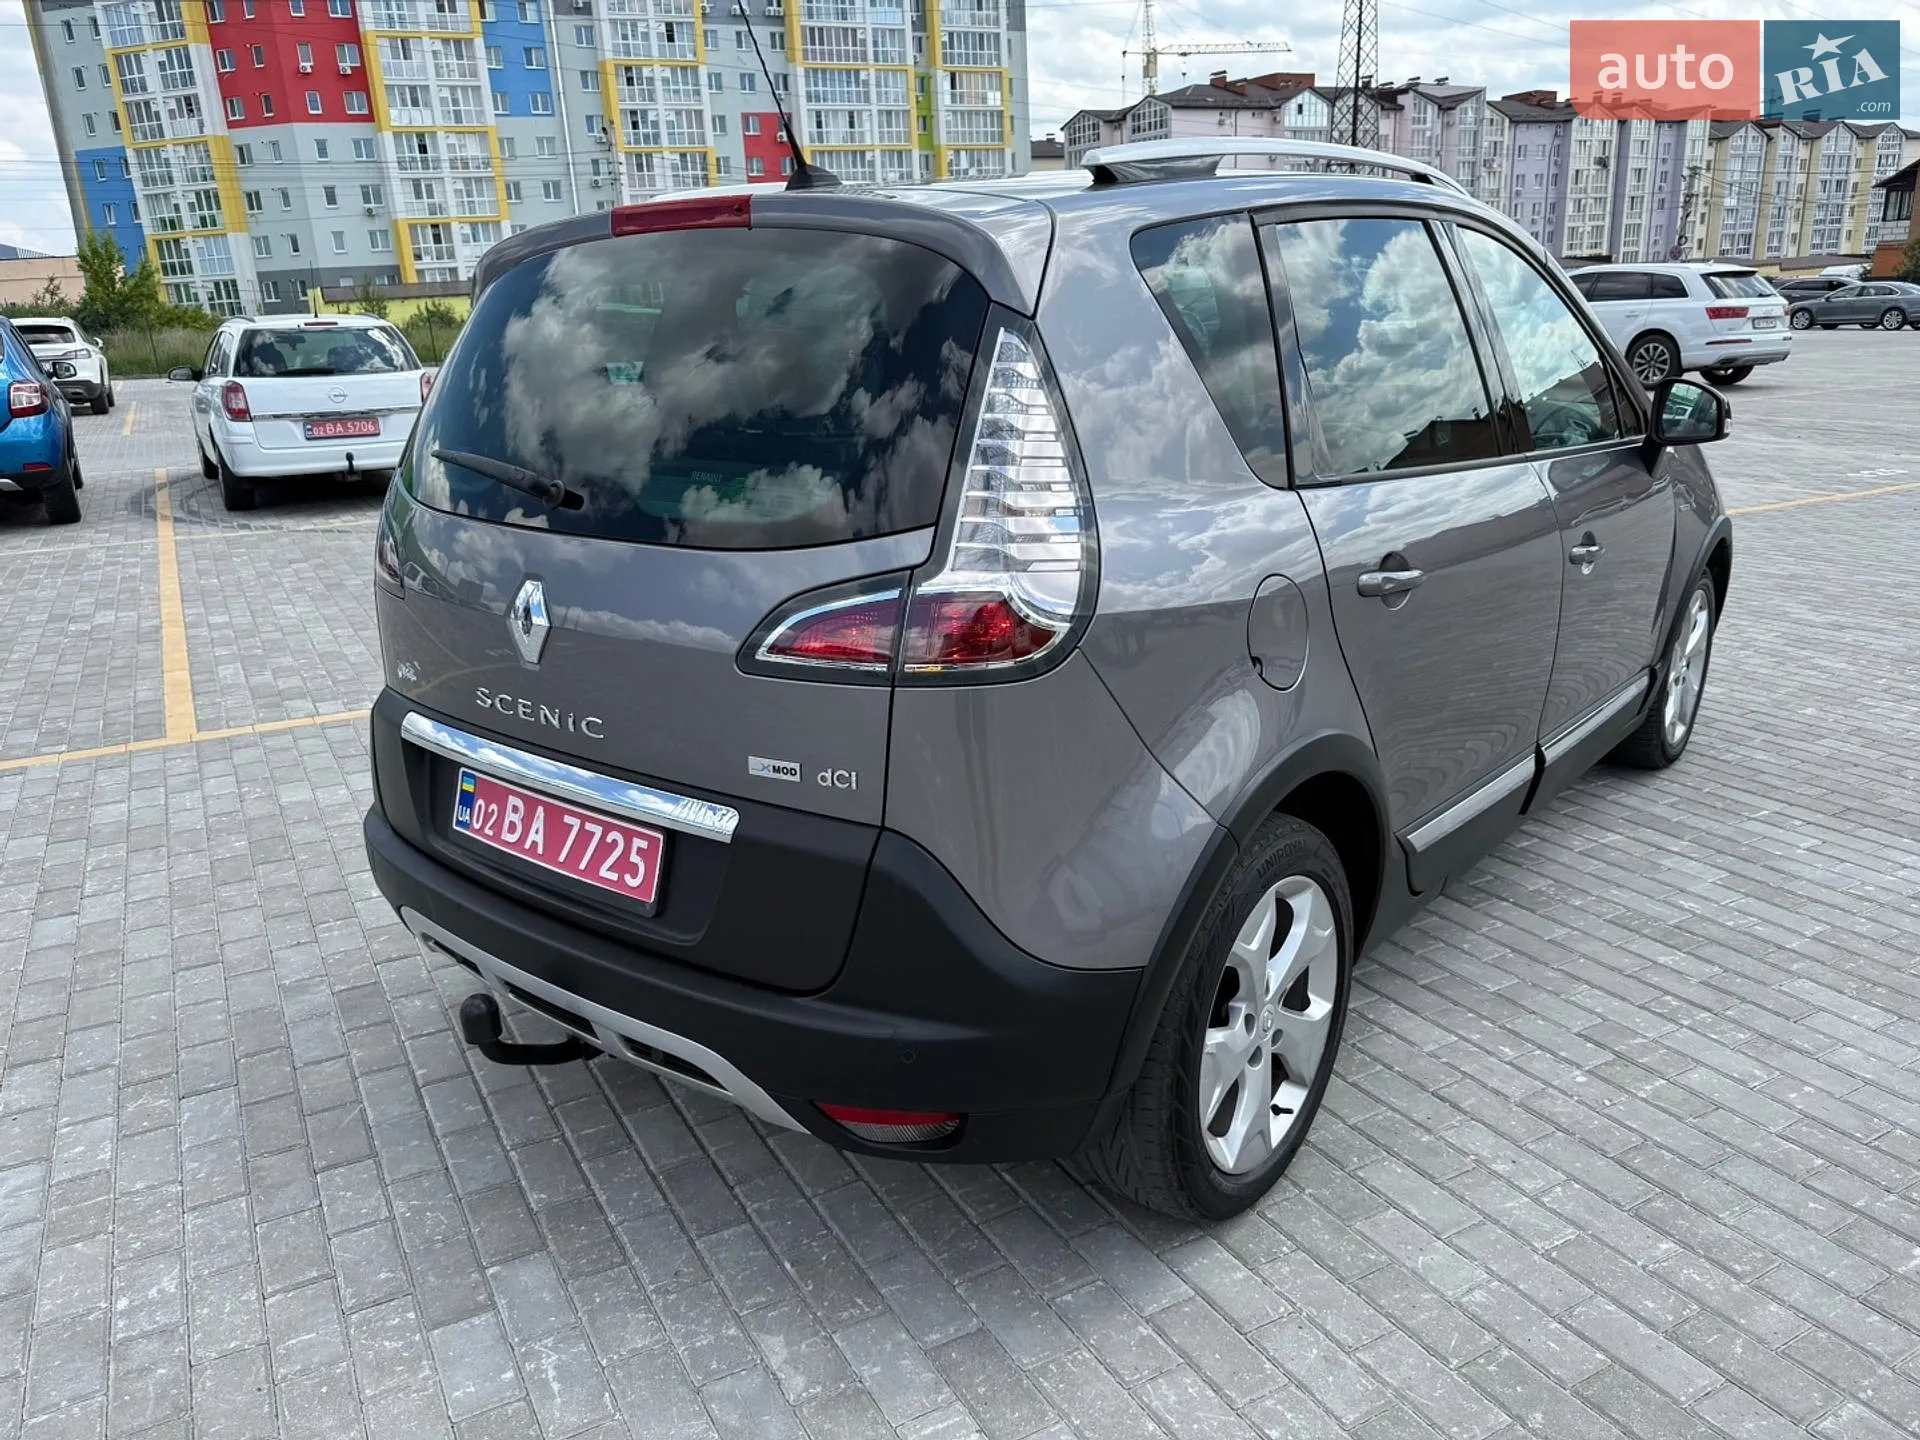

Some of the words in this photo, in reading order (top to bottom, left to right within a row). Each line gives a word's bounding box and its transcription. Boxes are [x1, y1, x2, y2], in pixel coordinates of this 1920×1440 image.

[313, 427, 324, 435] 02
[325, 423, 344, 434] BA
[347, 421, 375, 432] 5706
[458, 805, 471, 824] UA
[472, 798, 498, 837] 02
[501, 794, 545, 855] BA
[558, 814, 649, 888] 7725
